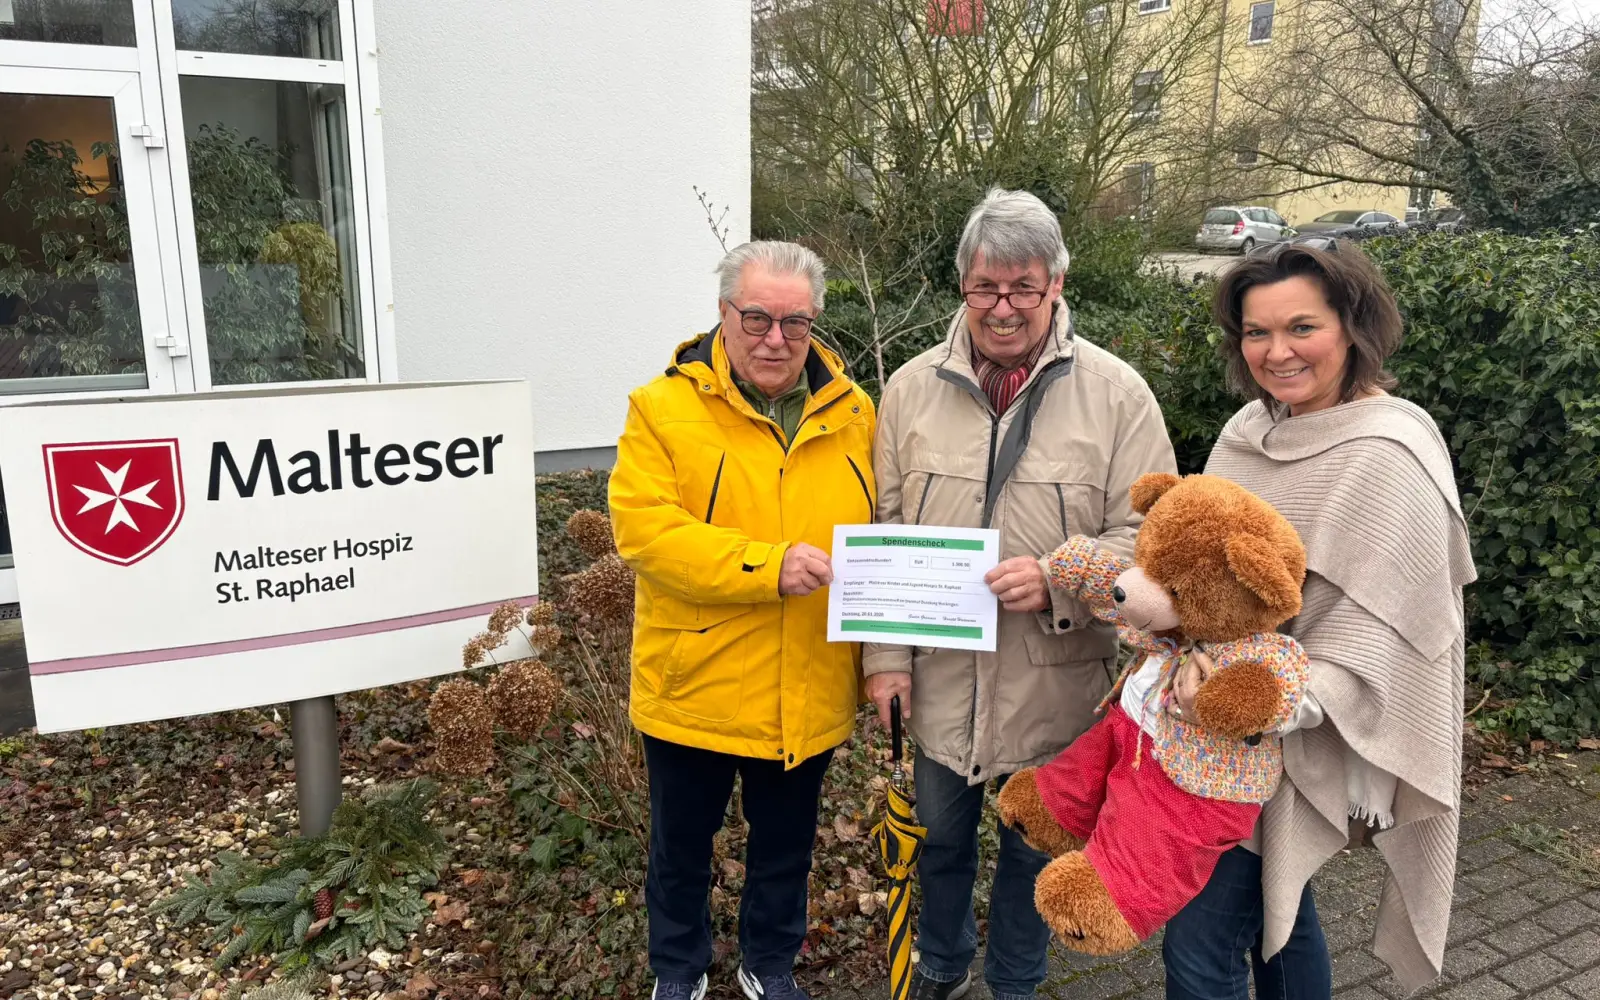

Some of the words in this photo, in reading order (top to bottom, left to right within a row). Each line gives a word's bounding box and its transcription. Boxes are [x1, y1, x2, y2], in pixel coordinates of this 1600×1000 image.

[207, 429, 504, 501] Malteser
[214, 545, 327, 573] Malteser
[333, 532, 414, 561] Hospiz
[881, 537, 946, 548] Spendenscheck
[216, 581, 251, 604] St.
[256, 566, 355, 602] Raphael
